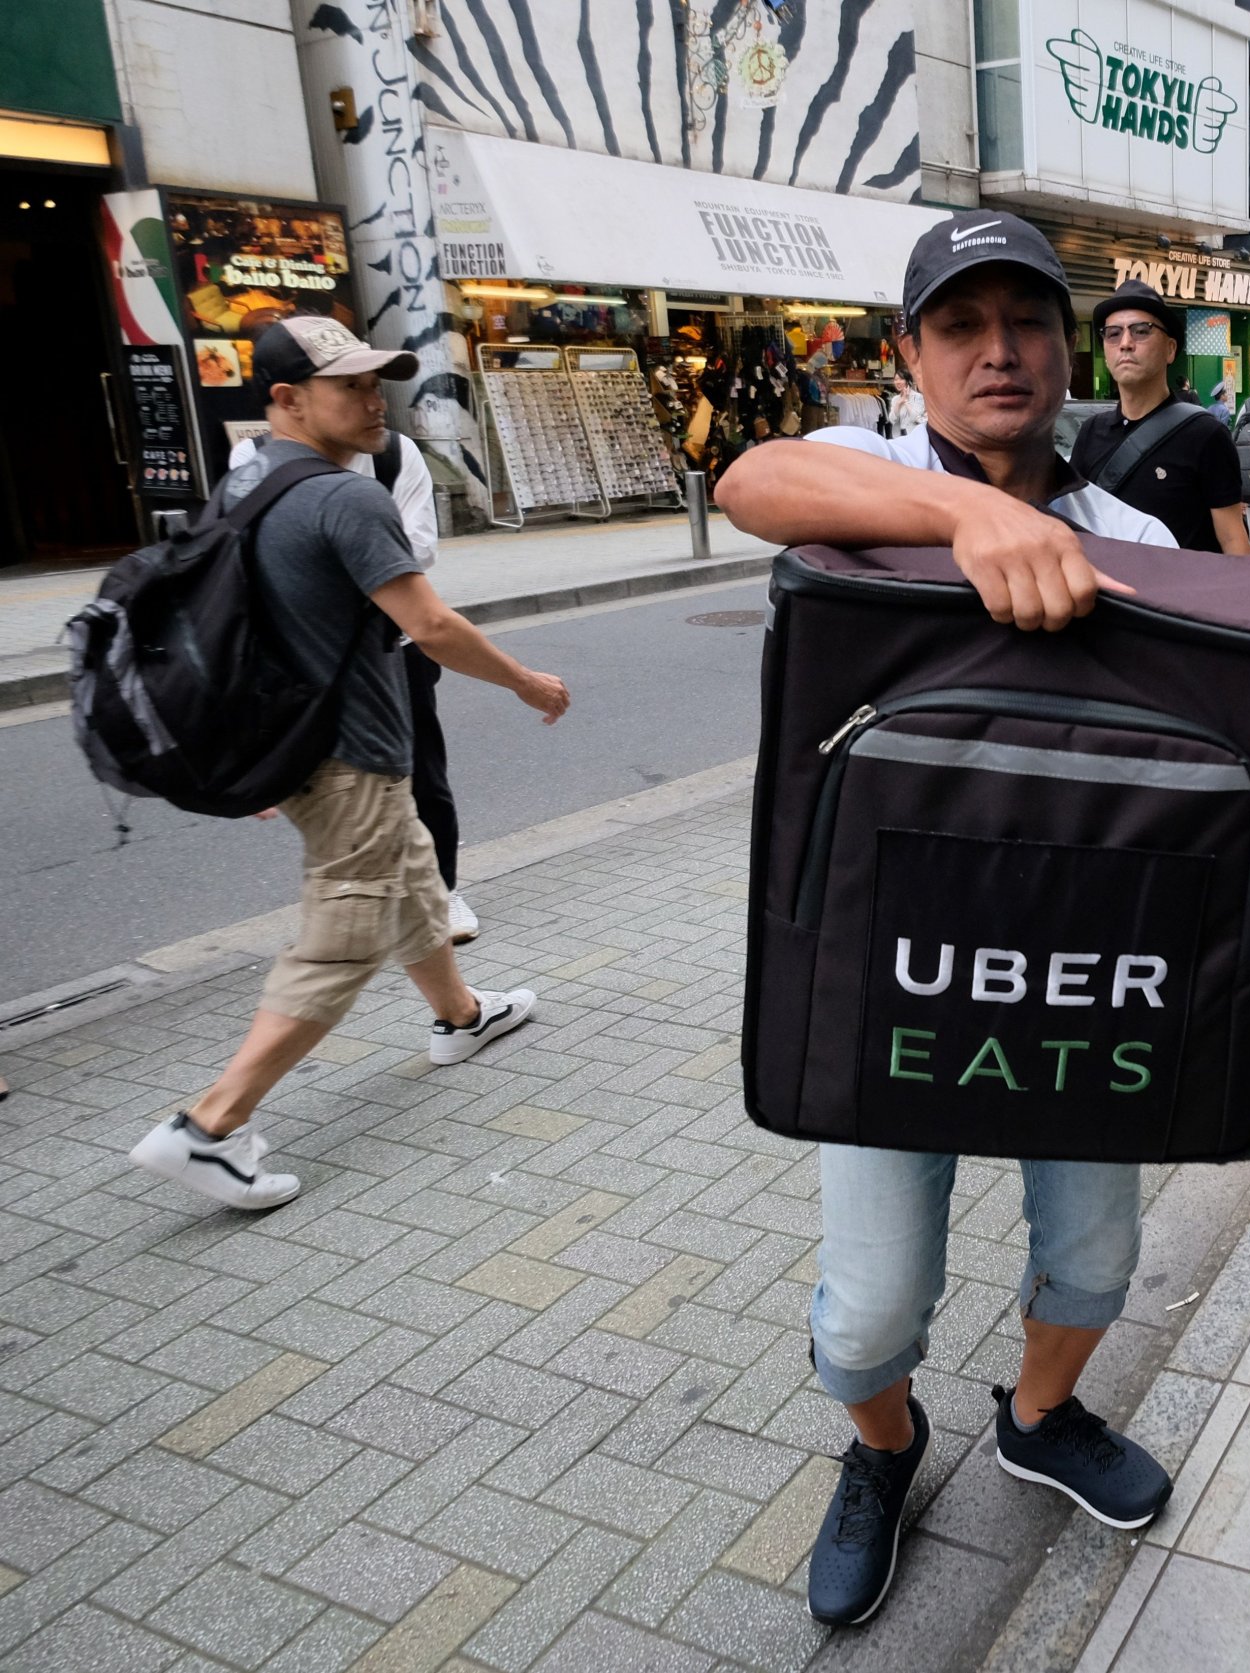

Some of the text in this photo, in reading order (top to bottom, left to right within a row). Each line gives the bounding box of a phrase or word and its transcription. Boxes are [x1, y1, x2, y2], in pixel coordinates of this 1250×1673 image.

[1113, 41, 1187, 75] CREATIVE LIFE STORE
[1106, 56, 1194, 114] TOKYU
[1102, 94, 1190, 150] HANDS
[371, 48, 427, 313] JUNCTION
[694, 201, 741, 213] MOUNTAIN
[744, 206, 791, 220] EQUIPMENT
[698, 210, 832, 249] FUNCTION
[952, 235, 1007, 253] SKATEBOARDING
[280, 258, 325, 274] Dining
[443, 243, 505, 260] FUNCTION
[445, 259, 507, 275] JUNCTION
[711, 237, 842, 273] JUNCTION
[1168, 250, 1231, 269] CREATIVE LIFE STORE
[720, 263, 762, 273] SHIBUYA
[766, 267, 798, 277] TOKYO
[798, 270, 825, 280] SINCE
[895, 937, 1168, 1008] UBER
[889, 1026, 1154, 1092] EATS
